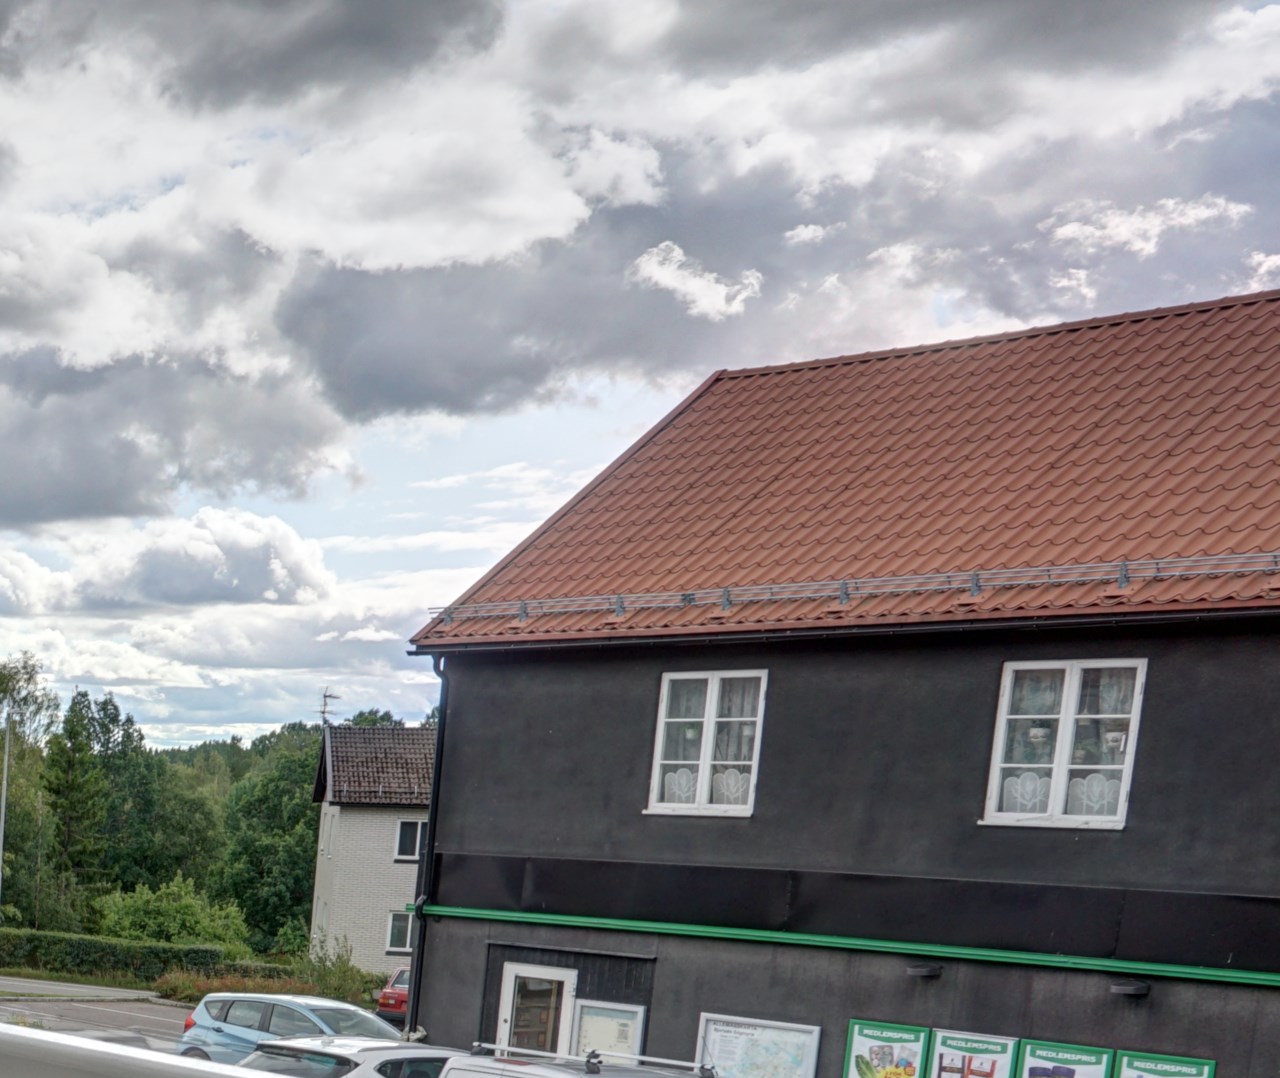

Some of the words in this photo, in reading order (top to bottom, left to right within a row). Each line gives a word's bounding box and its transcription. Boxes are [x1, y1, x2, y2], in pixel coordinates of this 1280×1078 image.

[946, 1040, 1002, 1052] MEDLEMSPRIS
[1035, 1050, 1096, 1063] MEDLEMSPRIS
[1133, 1061, 1197, 1074] MEDLEMSPRIS
